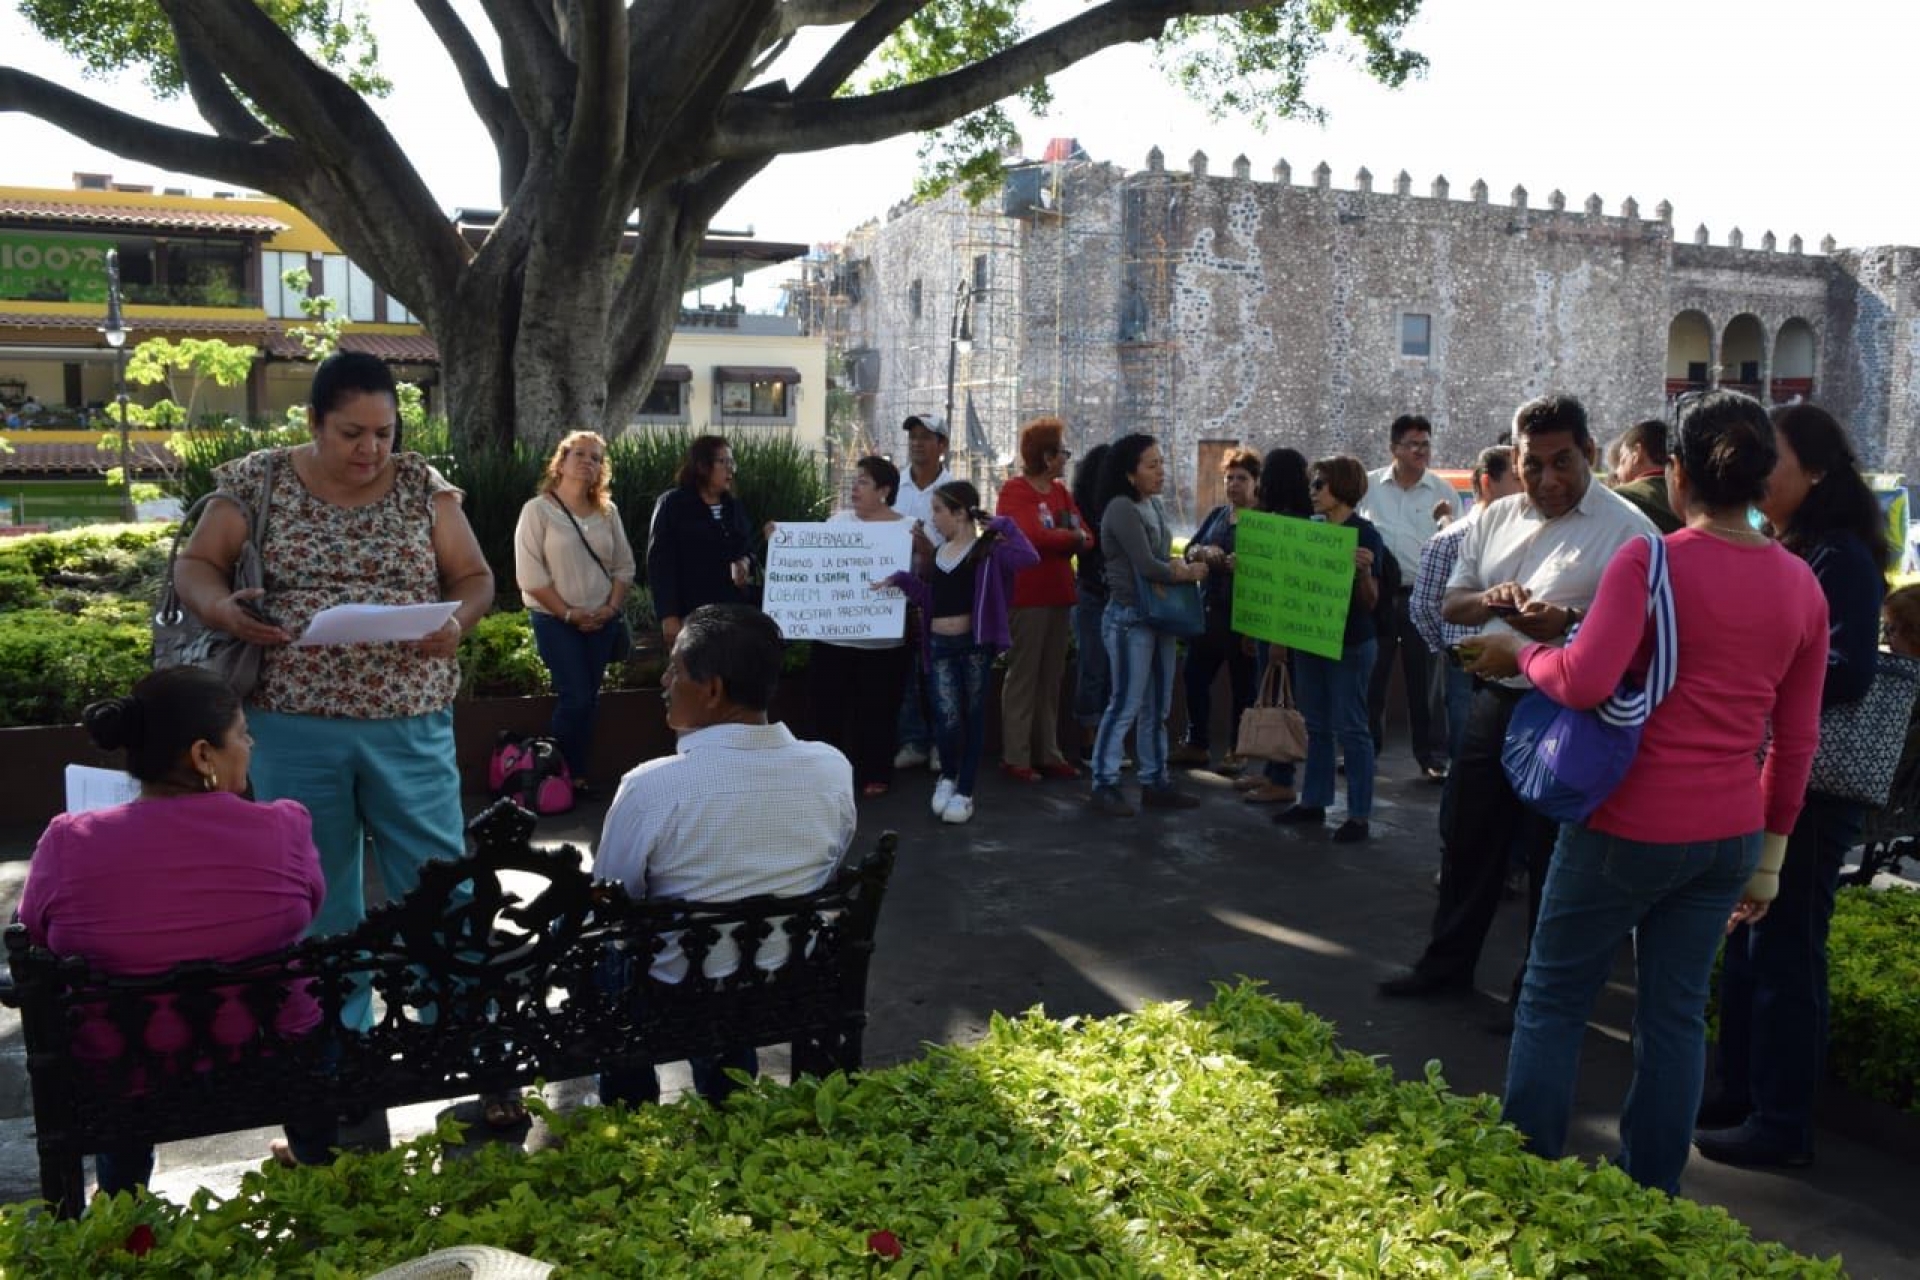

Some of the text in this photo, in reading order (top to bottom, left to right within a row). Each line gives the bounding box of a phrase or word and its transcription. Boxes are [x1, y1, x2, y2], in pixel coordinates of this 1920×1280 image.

[2, 243, 103, 271] 100%
[821, 557, 833, 568] LA
[836, 556, 874, 567] ENTREGA
[879, 556, 897, 566] DEL
[768, 586, 821, 603] COBAEM
[831, 589, 855, 601] PARA
[787, 608, 832, 621] NUESTRA
[788, 624, 808, 636] POR
